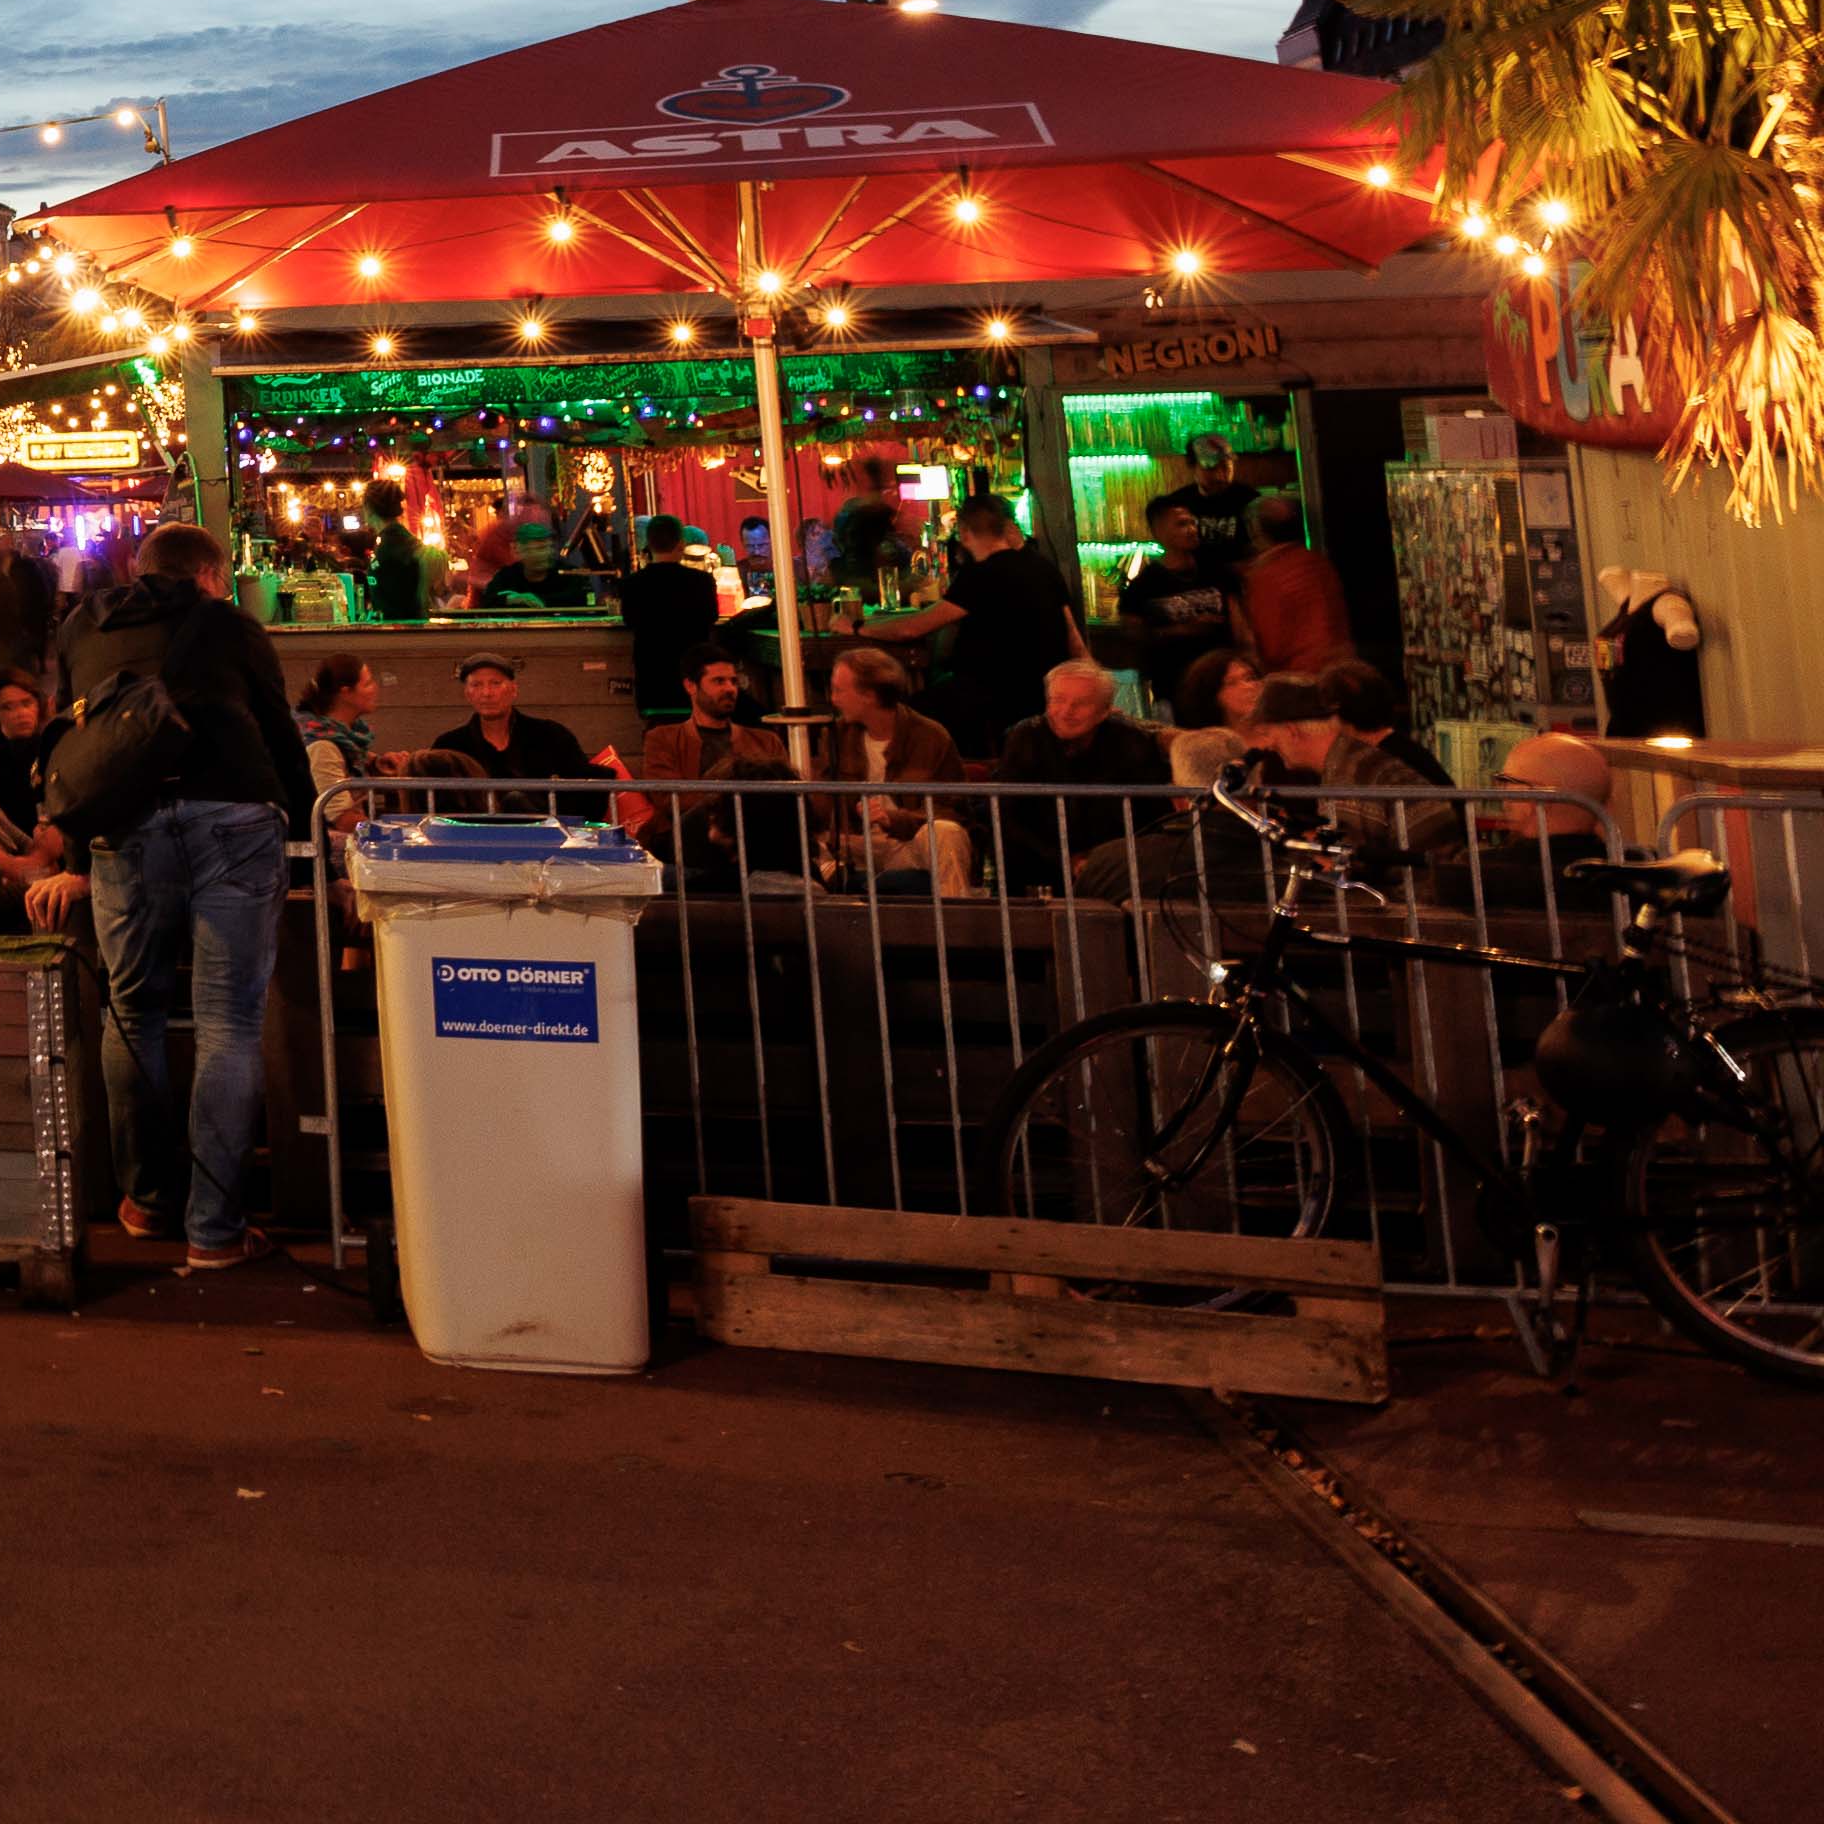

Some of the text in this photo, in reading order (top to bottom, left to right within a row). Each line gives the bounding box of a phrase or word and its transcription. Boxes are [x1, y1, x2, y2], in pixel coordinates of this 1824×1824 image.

[536, 119, 999, 164] ASTRA
[1104, 326, 1280, 376] NEGRONI
[417, 369, 485, 387] BIONADE
[259, 387, 343, 407] ERDINGER
[457, 967, 502, 982] OTTO
[442, 1019, 589, 1037] www.doerner-direkt.de
